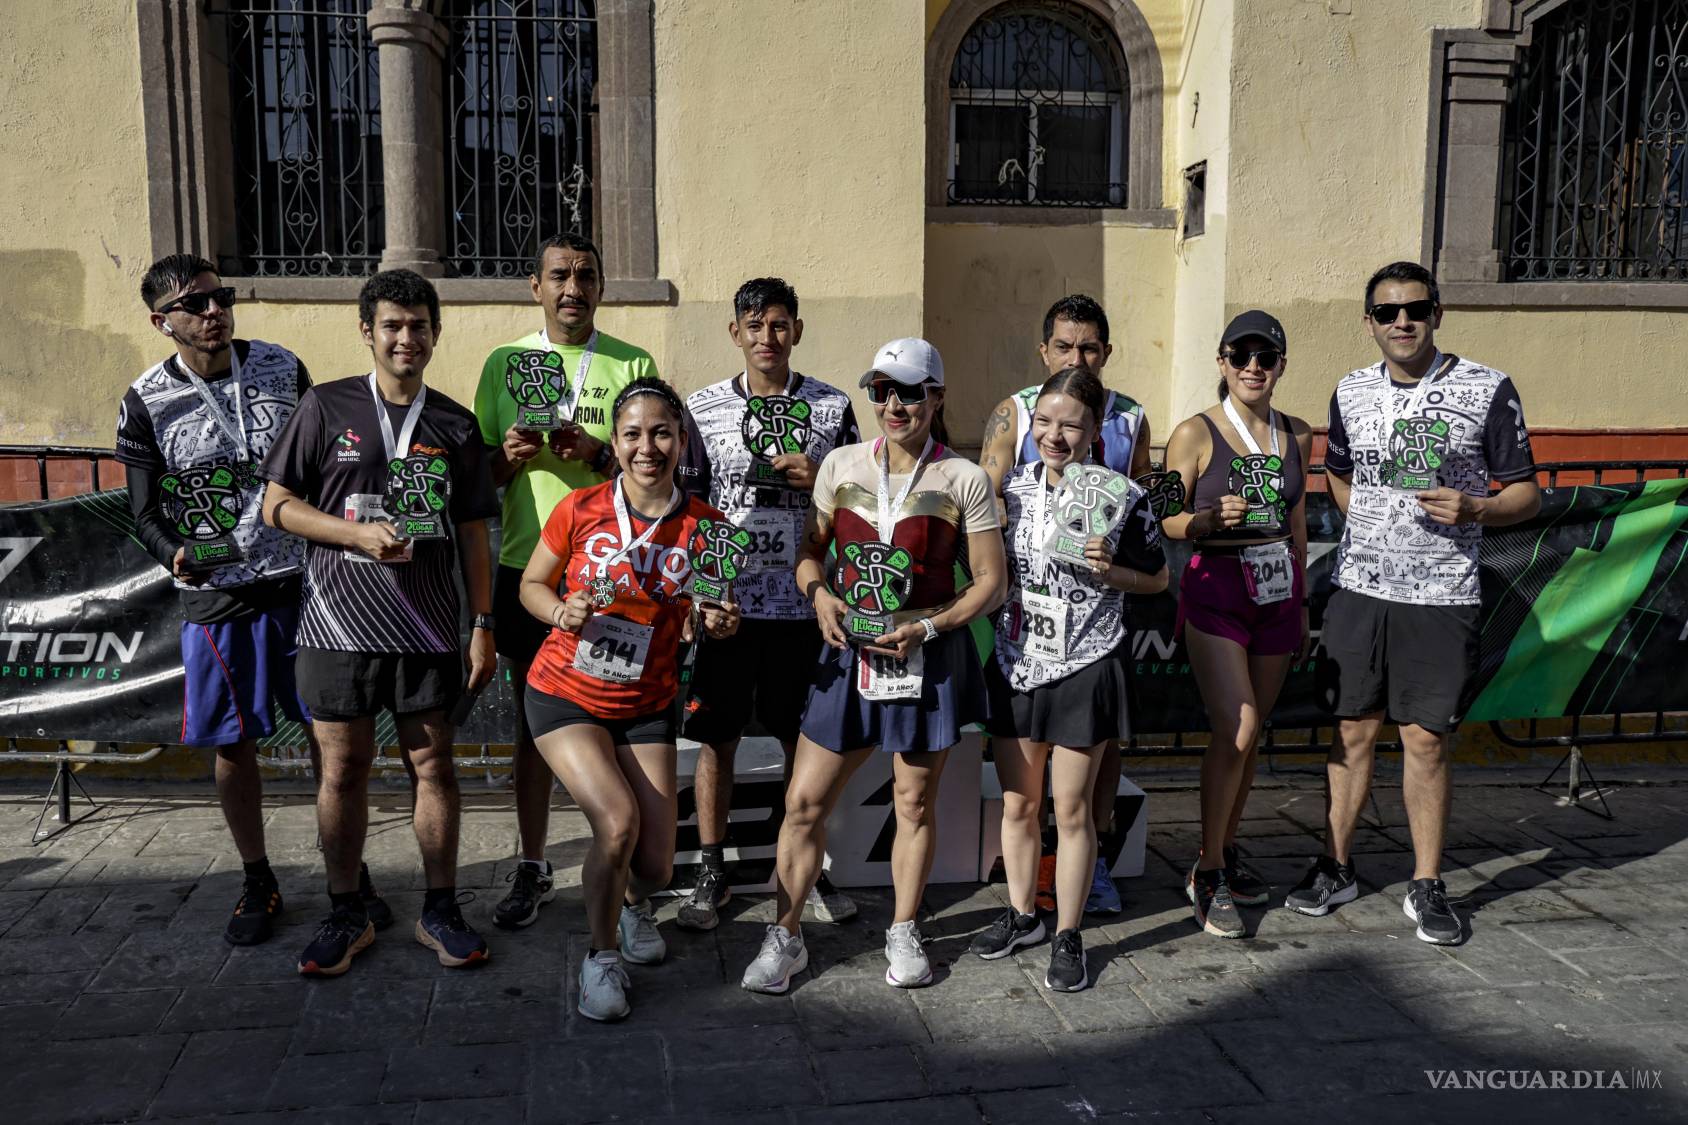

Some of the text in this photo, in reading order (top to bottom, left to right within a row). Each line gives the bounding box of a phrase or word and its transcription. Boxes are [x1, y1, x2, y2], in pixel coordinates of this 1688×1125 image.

[202, 547, 229, 556] LUGAR
[1252, 559, 1289, 585] 204
[859, 623, 884, 633] LUGAR
[1022, 610, 1057, 640] 283
[589, 636, 637, 668] 614
[1034, 642, 1042, 650] 10
